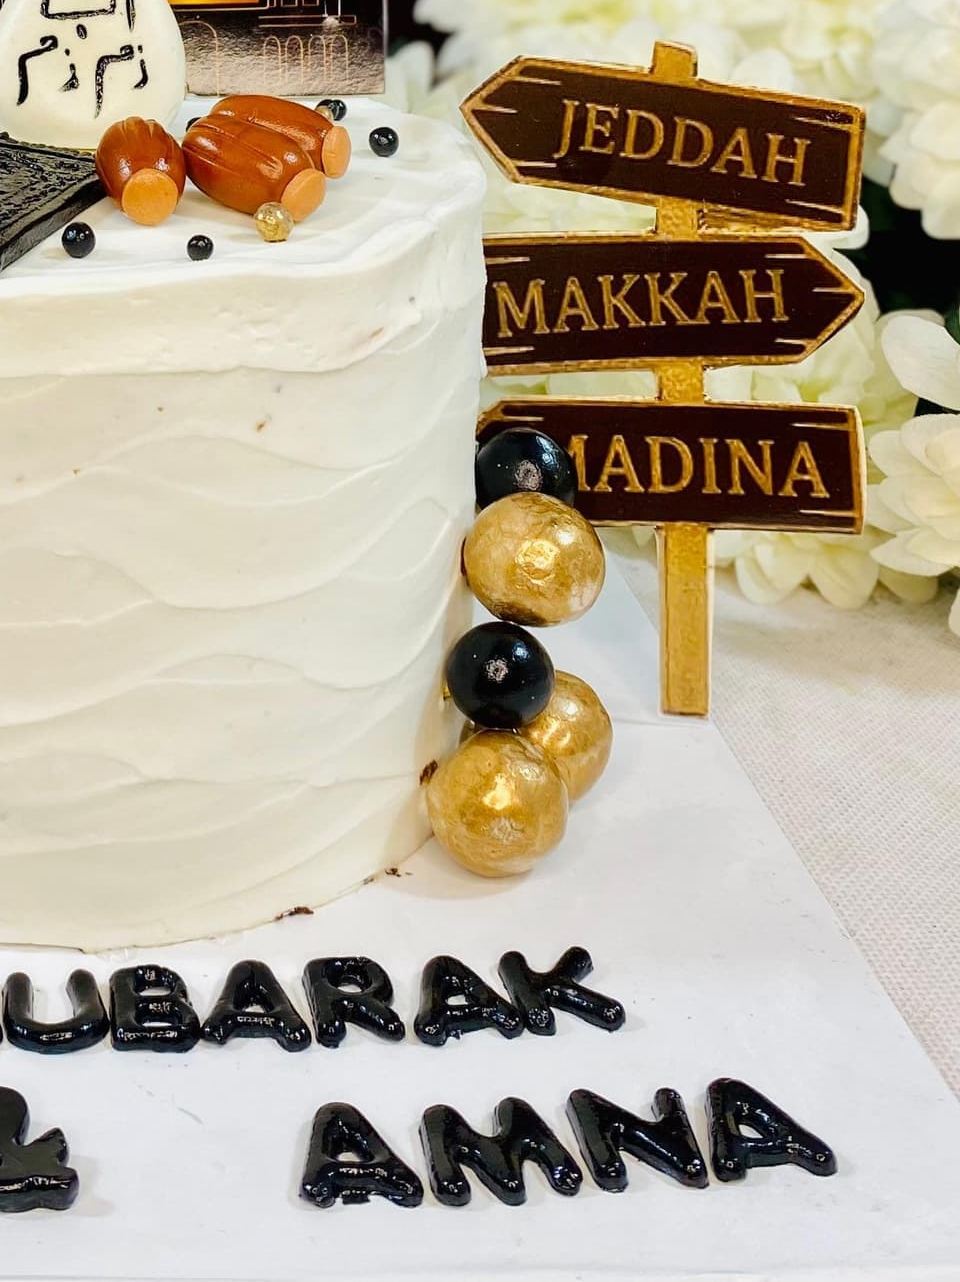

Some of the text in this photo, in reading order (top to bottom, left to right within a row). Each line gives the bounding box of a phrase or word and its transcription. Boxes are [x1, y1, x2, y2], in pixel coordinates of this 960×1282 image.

[552, 99, 811, 186] JEDDAH
[492, 269, 790, 338] MAKKAH
[298, 1077, 838, 1210] AMNA
